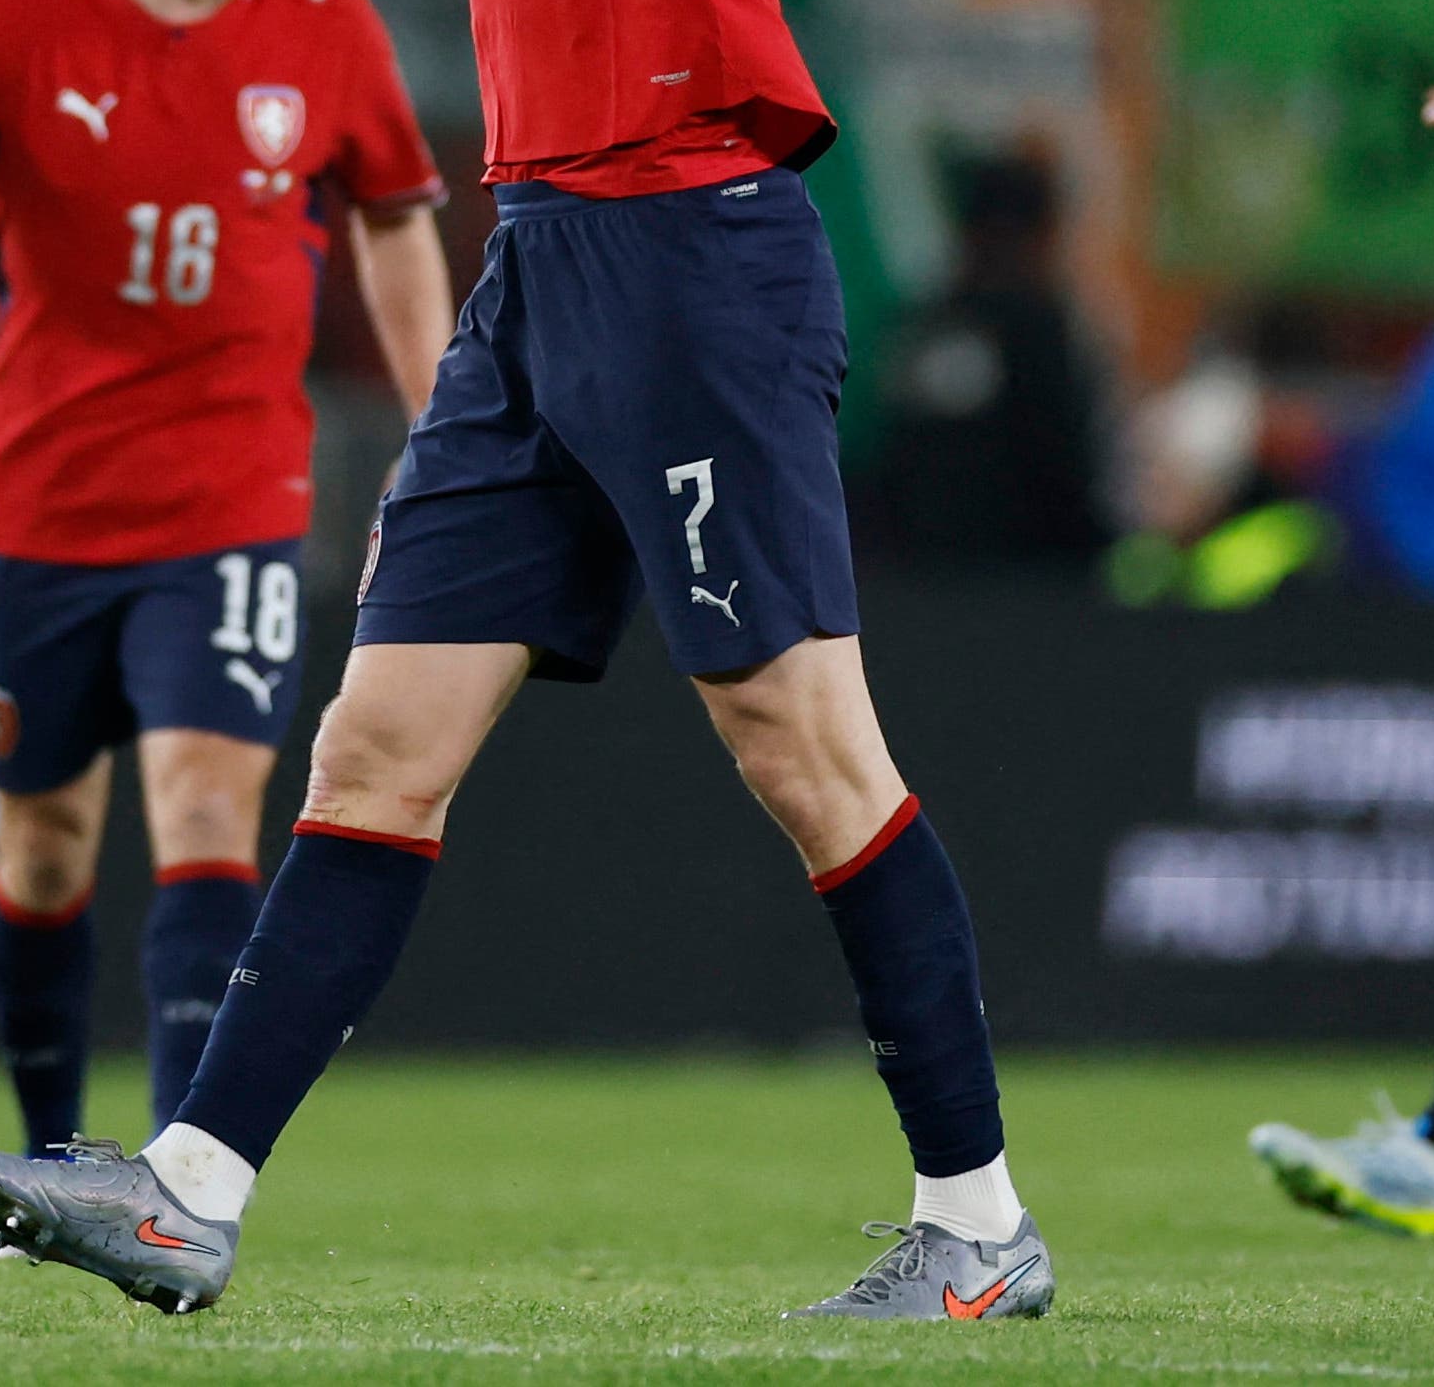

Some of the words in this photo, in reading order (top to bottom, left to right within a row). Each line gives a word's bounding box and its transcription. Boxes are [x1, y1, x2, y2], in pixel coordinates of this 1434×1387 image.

[117, 201, 220, 307] 18
[665, 457, 715, 575] 7
[210, 551, 299, 663] 18
